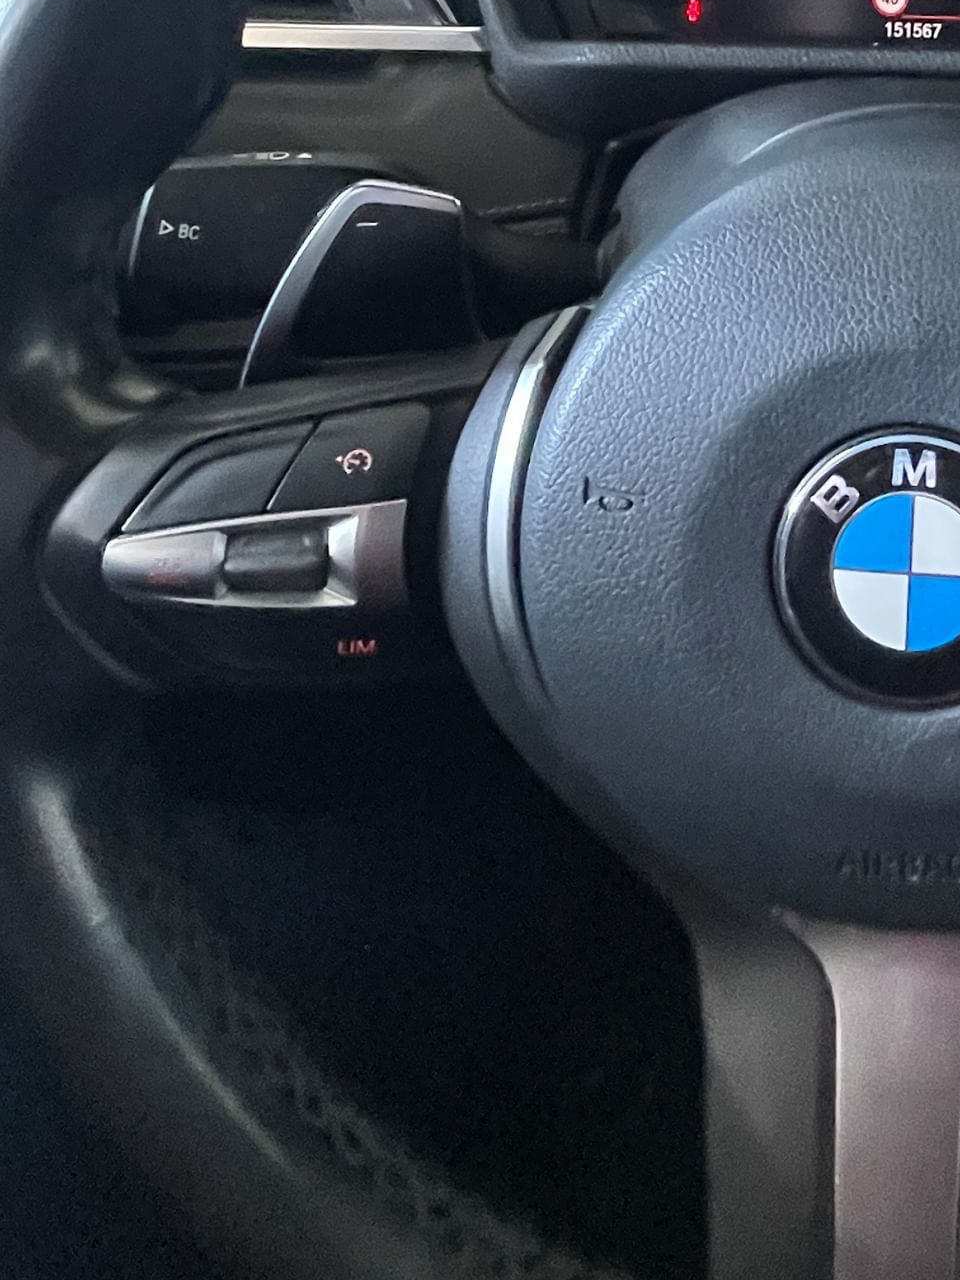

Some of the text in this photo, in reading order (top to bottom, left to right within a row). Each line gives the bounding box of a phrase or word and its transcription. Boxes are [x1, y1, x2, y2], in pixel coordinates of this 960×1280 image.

[884, 21, 943, 40] 151567
[177, 223, 201, 240] BC
[337, 639, 376, 654] LIM
